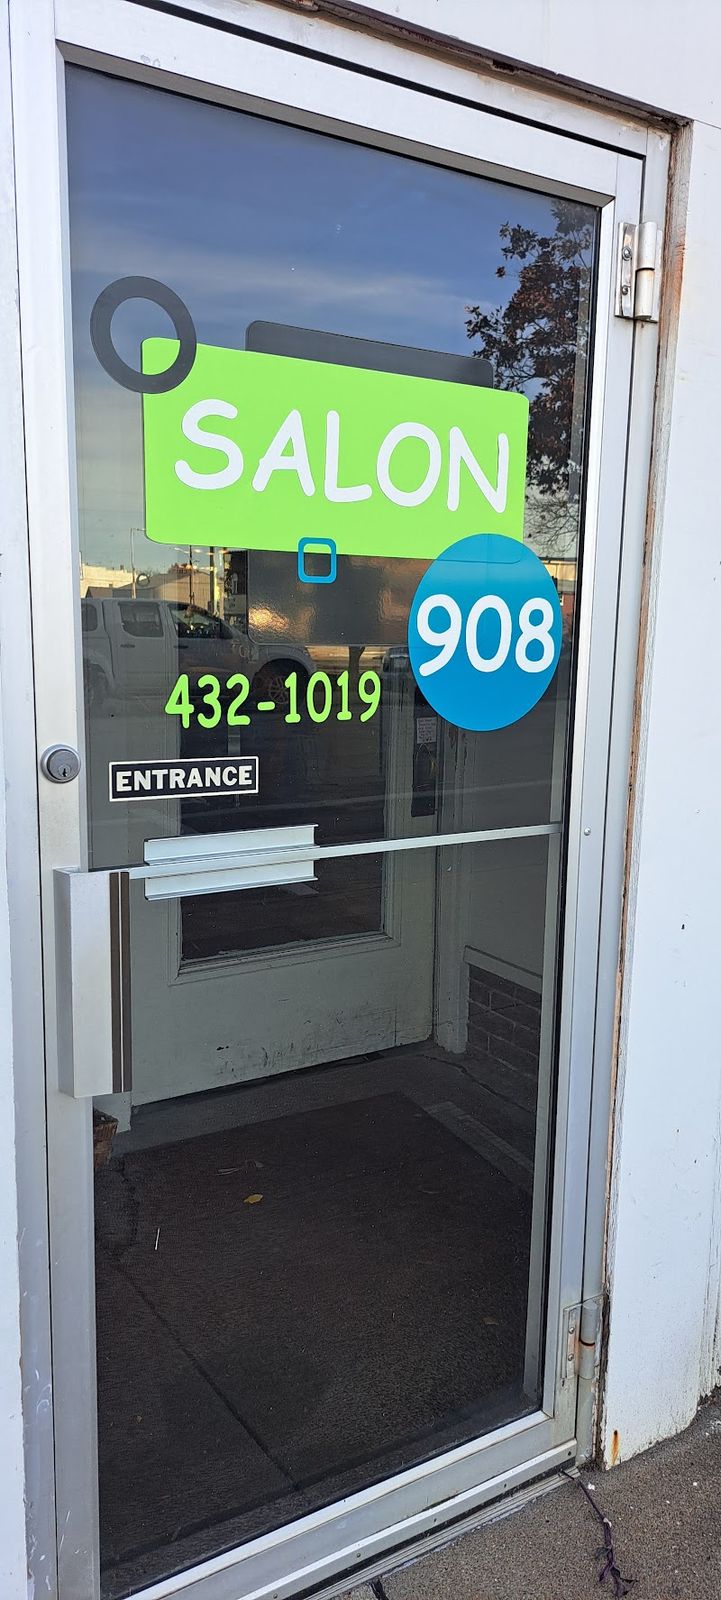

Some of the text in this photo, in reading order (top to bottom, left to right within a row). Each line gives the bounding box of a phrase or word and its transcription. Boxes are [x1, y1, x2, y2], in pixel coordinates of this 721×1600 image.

[174, 398, 509, 513] SALON
[417, 594, 555, 677] 908
[164, 671, 381, 729] 432-1019
[115, 765, 253, 792] ENTRANCE
